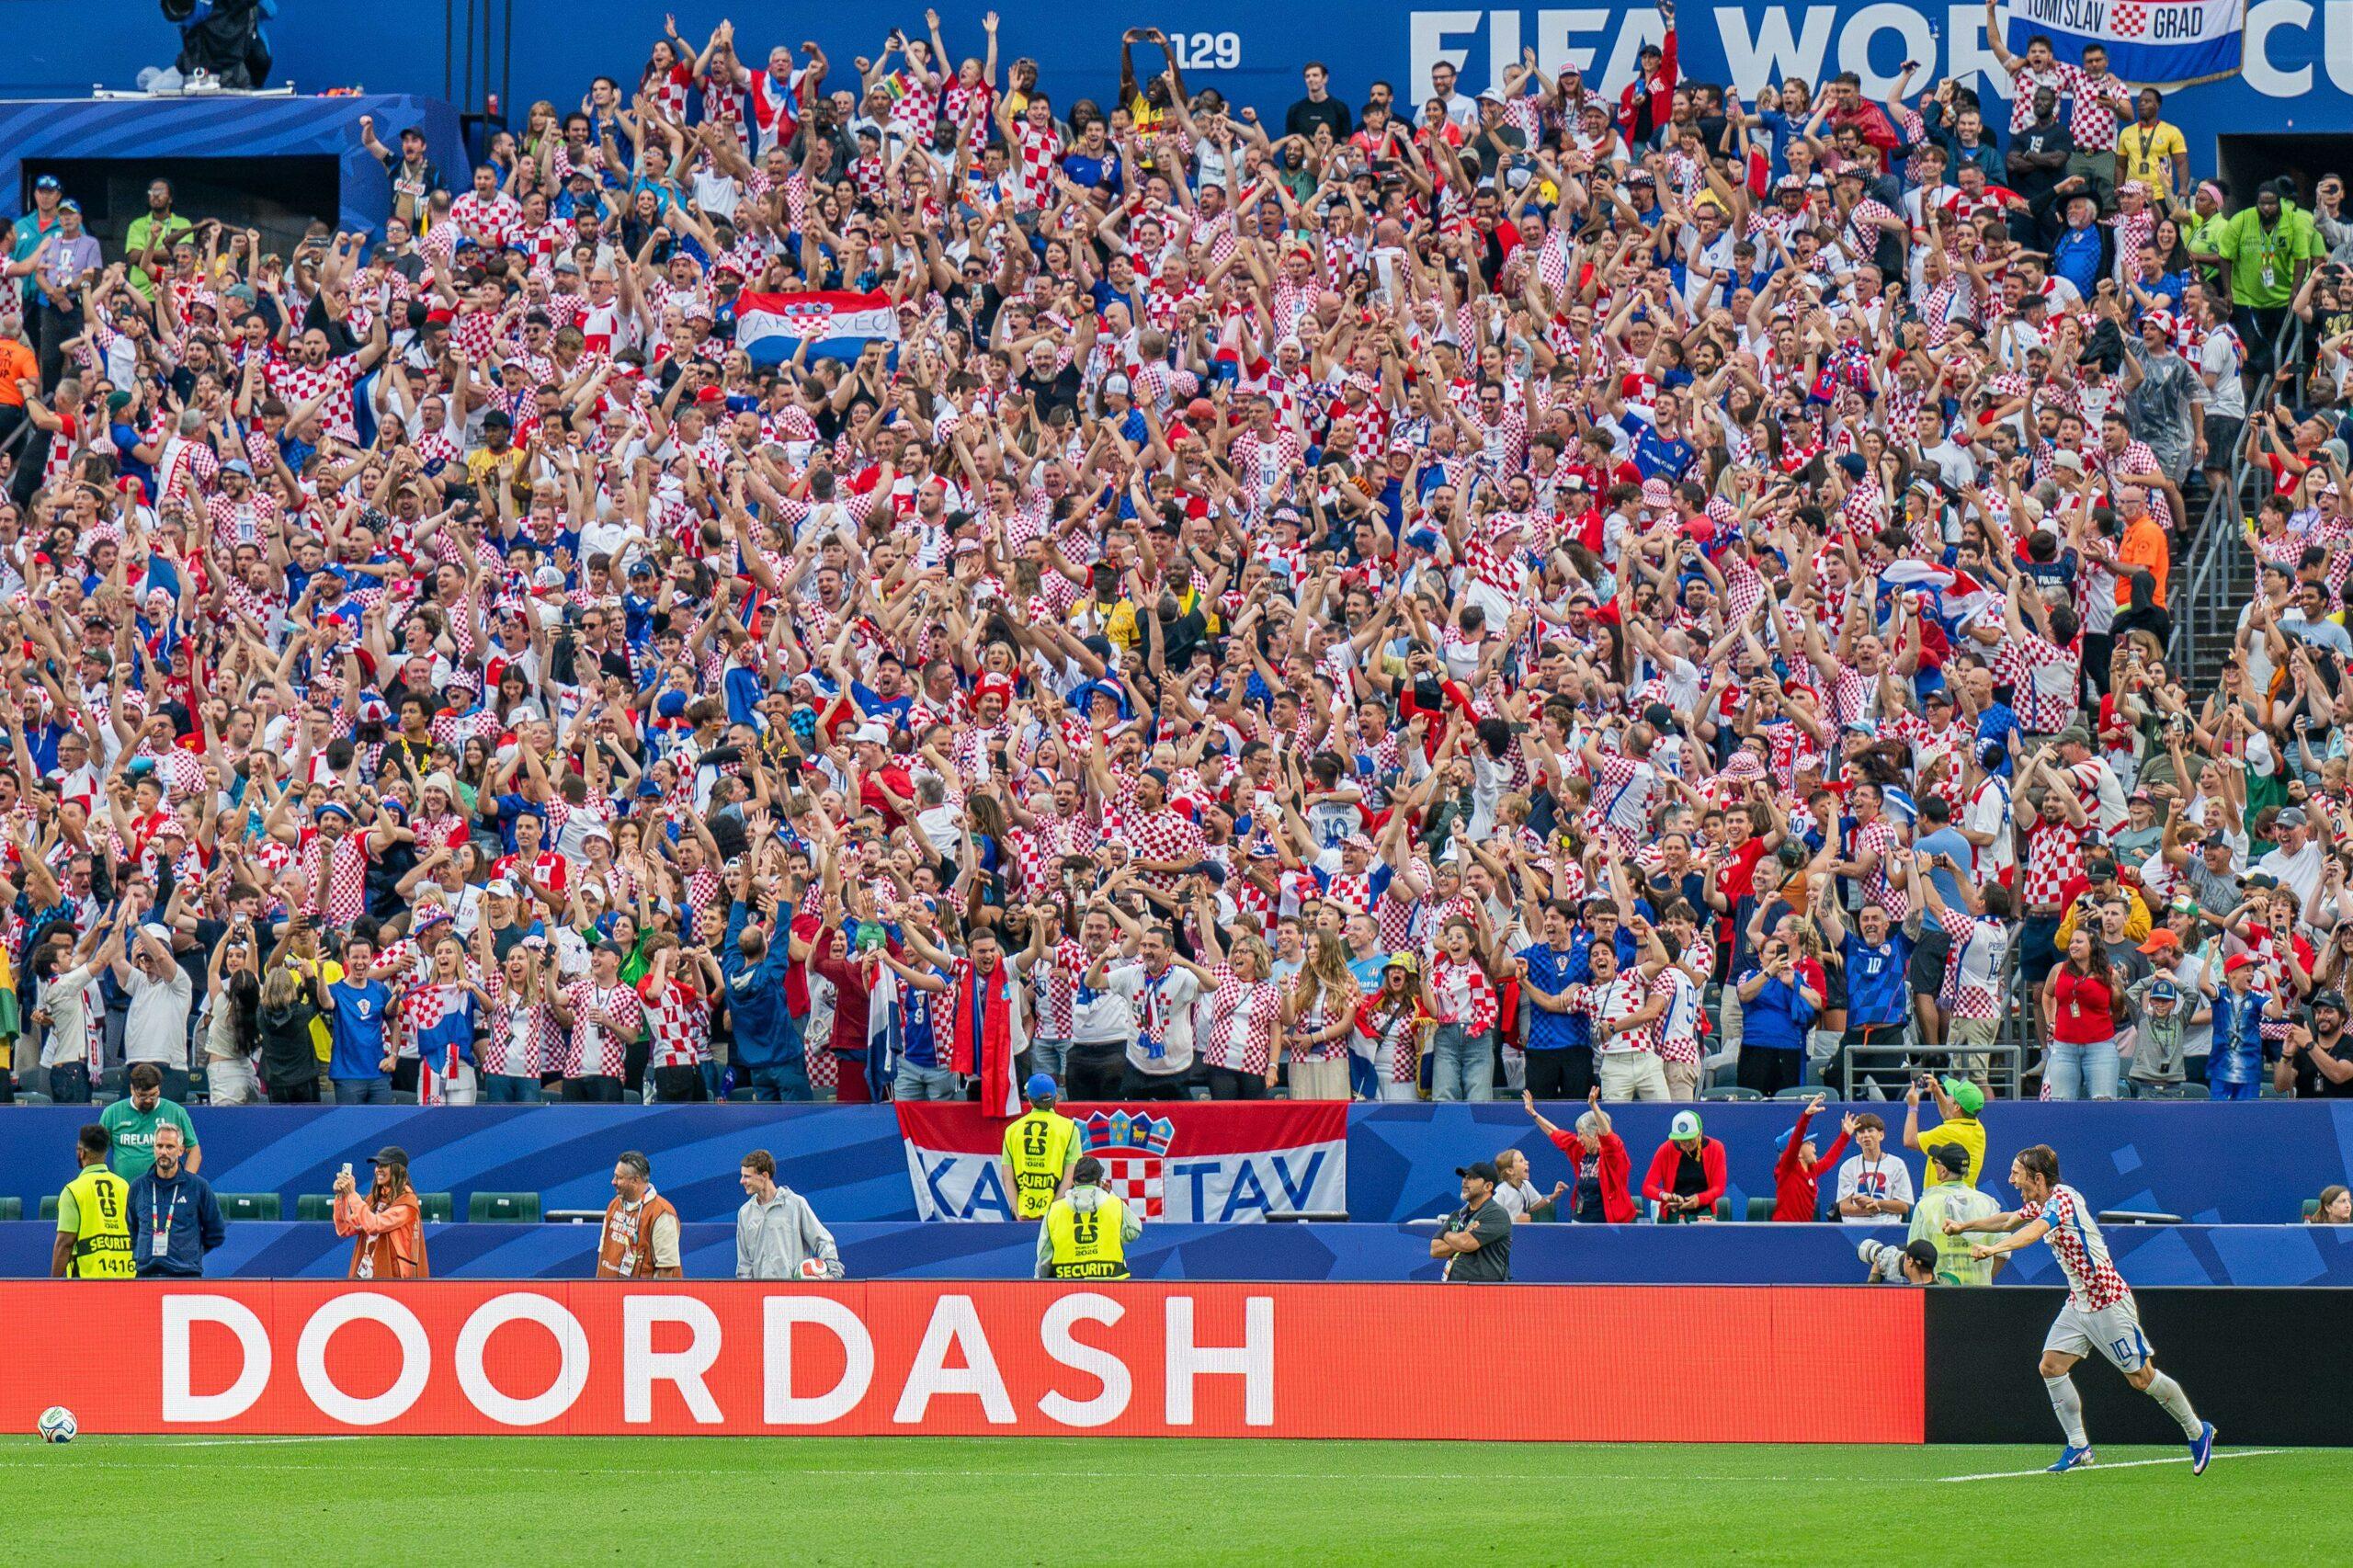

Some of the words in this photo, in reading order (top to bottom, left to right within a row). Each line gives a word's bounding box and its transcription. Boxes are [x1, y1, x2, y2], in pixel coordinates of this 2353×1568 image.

[2154, 6, 2203, 39] GRAD
[1170, 32, 1240, 70] 129
[1410, 8, 1684, 105] FIFA
[1262, 470, 1277, 486] 10
[1789, 816, 1805, 835] 10
[1866, 957, 1882, 974] 10
[1686, 983, 1696, 1025] 9
[666, 1006, 675, 1023] 7
[914, 1007, 925, 1025] 9
[120, 1132, 155, 1146] IRELAN
[1173, 1149, 1327, 1223] TAV
[98, 1258, 136, 1274] 1416
[1055, 1263, 1116, 1278] SECURITY
[2109, 1337, 2132, 1360] 10
[161, 1291, 1275, 1427] DOORDASH
